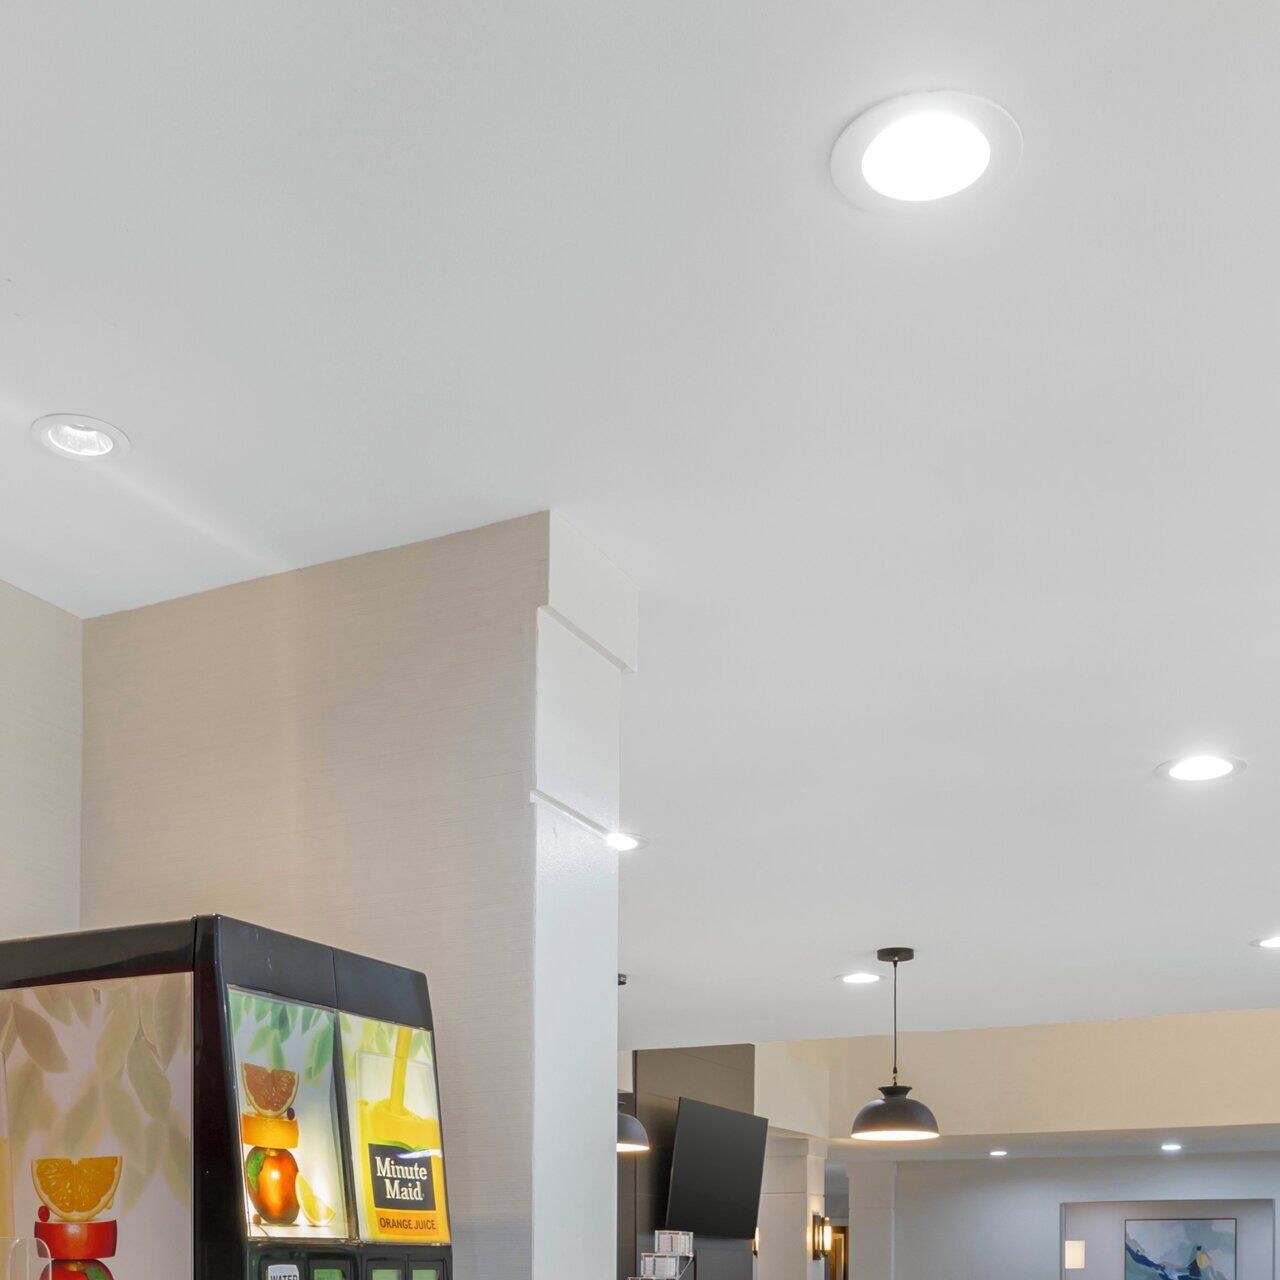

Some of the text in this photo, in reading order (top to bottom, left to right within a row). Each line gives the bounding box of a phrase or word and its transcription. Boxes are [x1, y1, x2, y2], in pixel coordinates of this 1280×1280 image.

[375, 1156, 428, 1181] Minute
[384, 1178, 424, 1201] Maid
[379, 1217, 437, 1230] ORANGE JUICE
